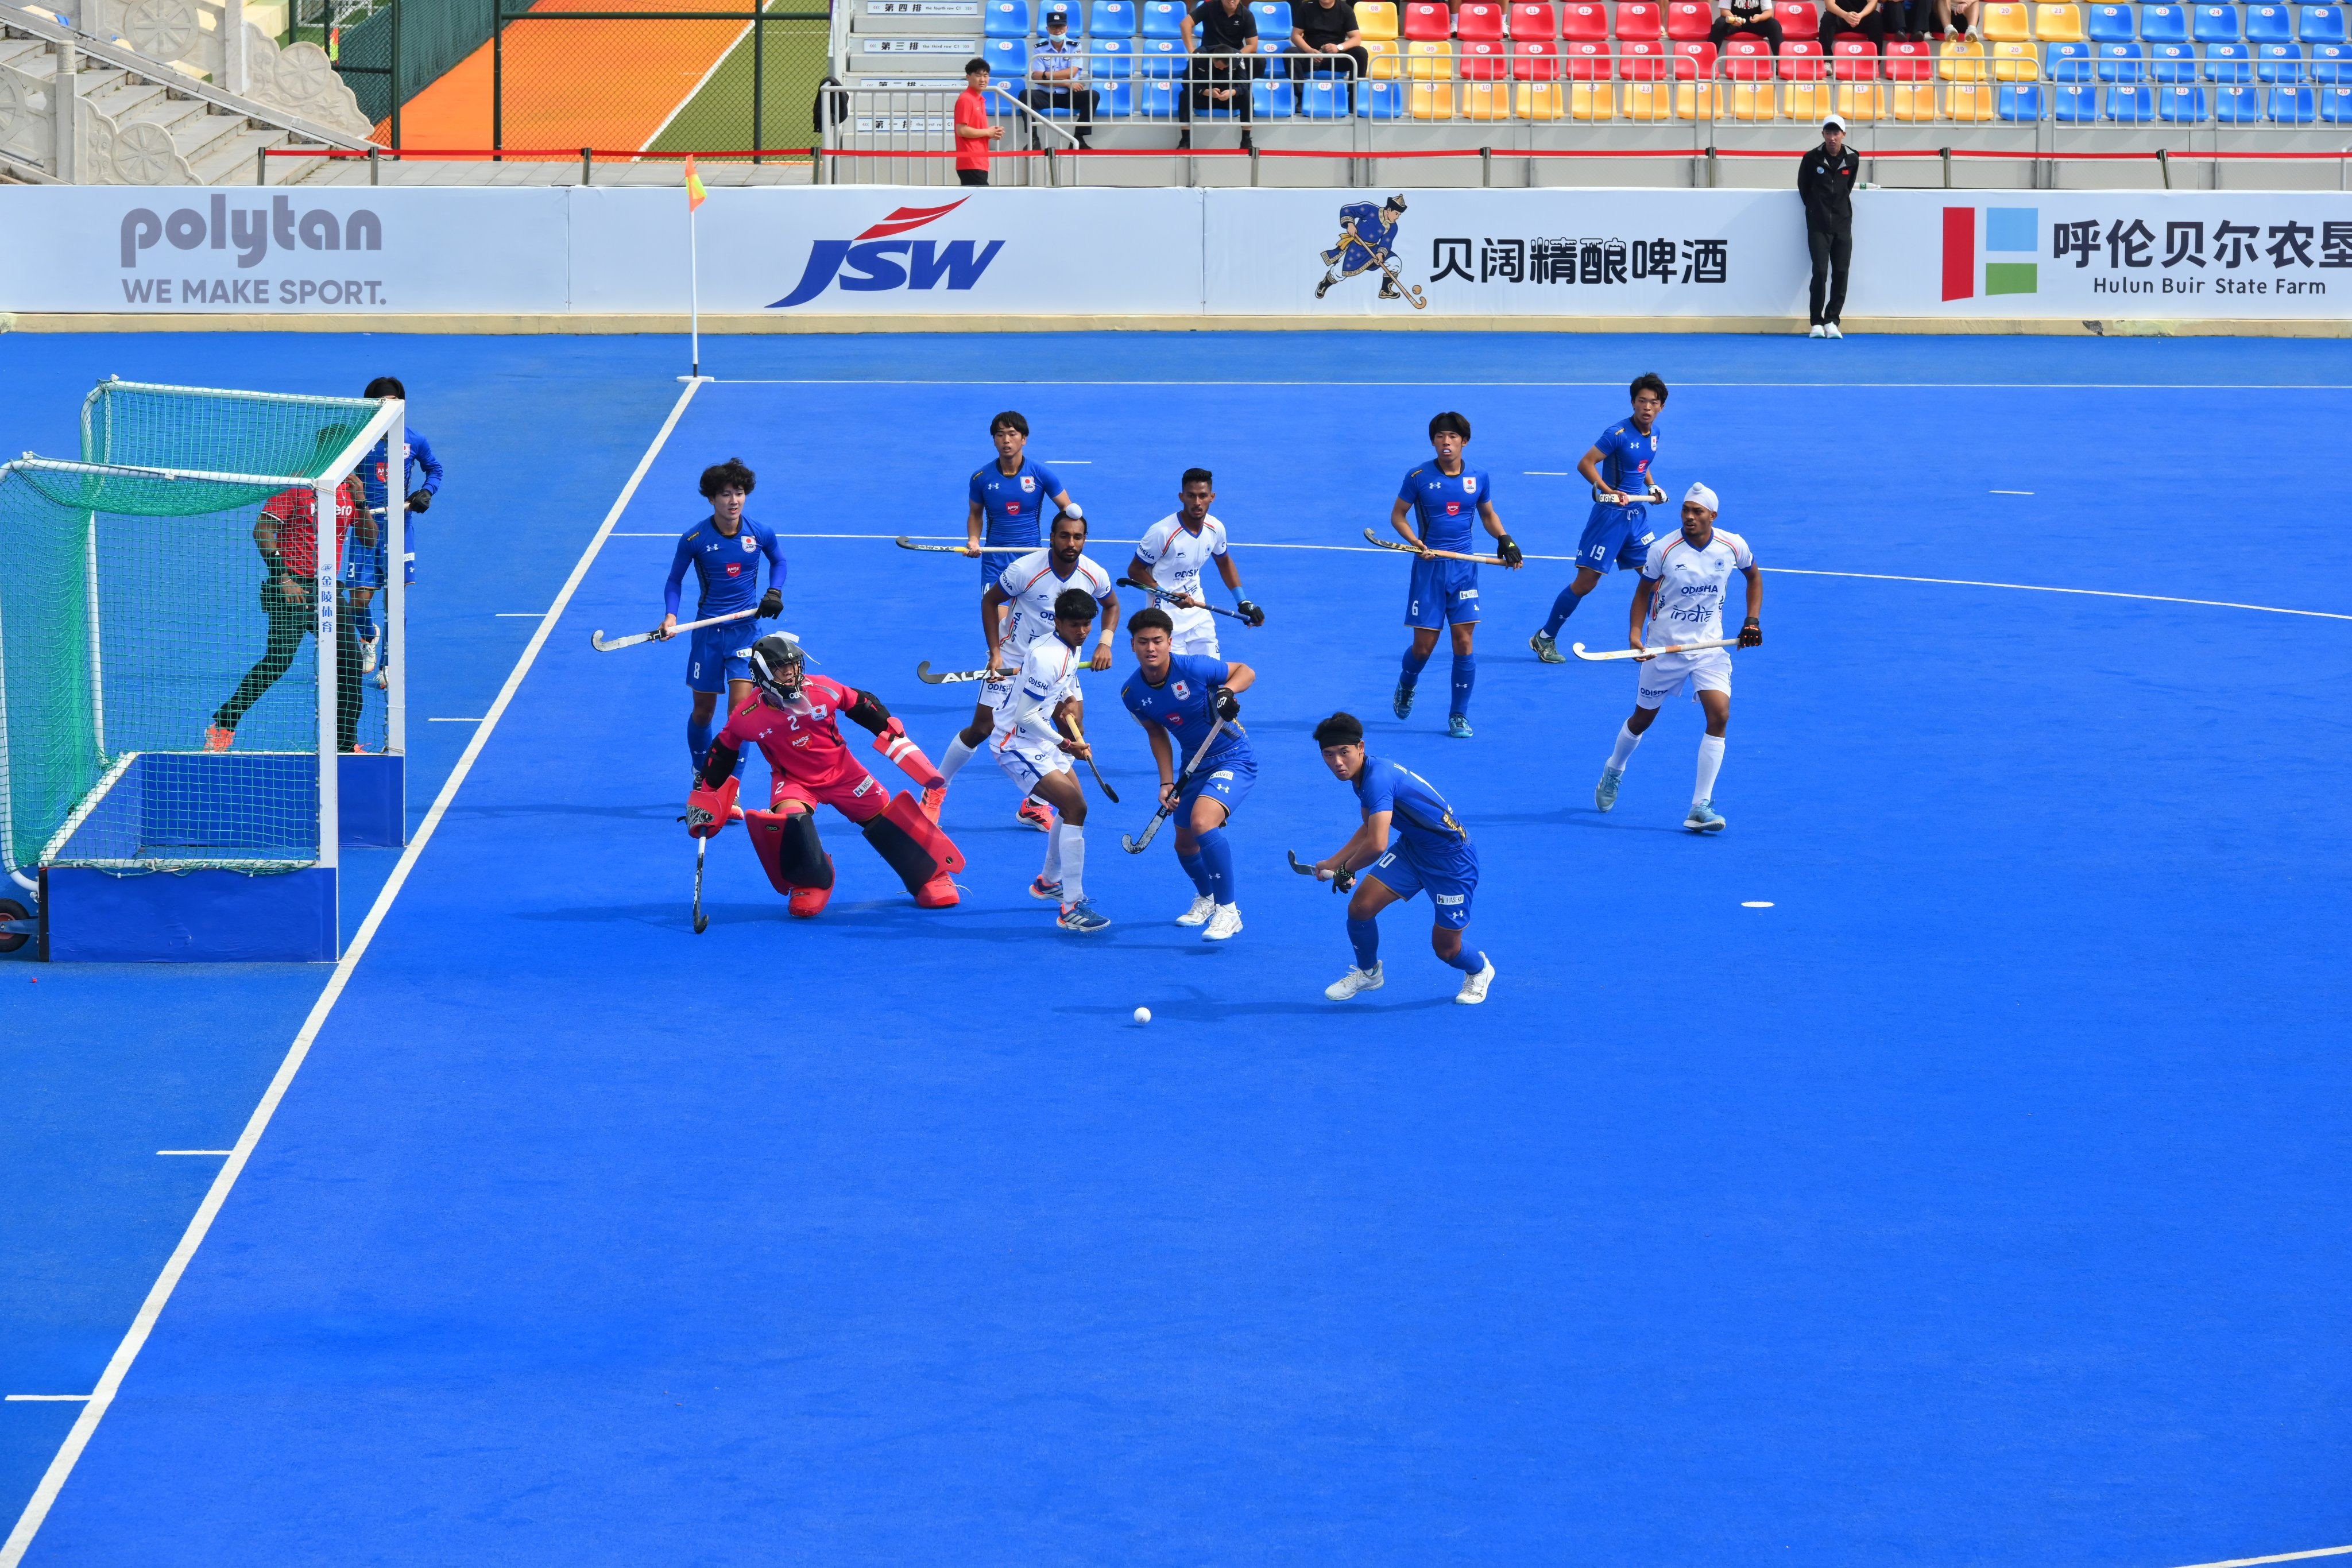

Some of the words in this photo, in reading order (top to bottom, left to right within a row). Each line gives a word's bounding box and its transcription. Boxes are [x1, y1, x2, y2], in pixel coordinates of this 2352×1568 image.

[884, 3, 922, 12] 第四排
[881, 42, 919, 51] 第三排
[121, 194, 382, 268] polytan
[1429, 237, 1728, 285] 贝阔精酿啤酒
[764, 240, 1007, 308] JSW
[122, 279, 172, 303] WE
[182, 280, 269, 304] MAKE
[279, 280, 386, 305] SPORT.
[2094, 277, 2153, 293] Hulun
[2162, 277, 2206, 293] Buir
[2215, 278, 2267, 294] State
[2276, 278, 2326, 294] Farm
[1589, 544, 1606, 561] 19
[1681, 584, 1718, 594] ODISHA
[321, 576, 333, 633] 金陵体育
[1412, 600, 1419, 616] 6
[694, 661, 701, 679] 8
[941, 669, 1001, 684] ALFA
[1028, 676, 1049, 691] ODISHA
[787, 715, 800, 731] 2
[792, 735, 809, 746] AMOS
[775, 781, 785, 795] 2
[1446, 895, 1463, 903] HASEKO
